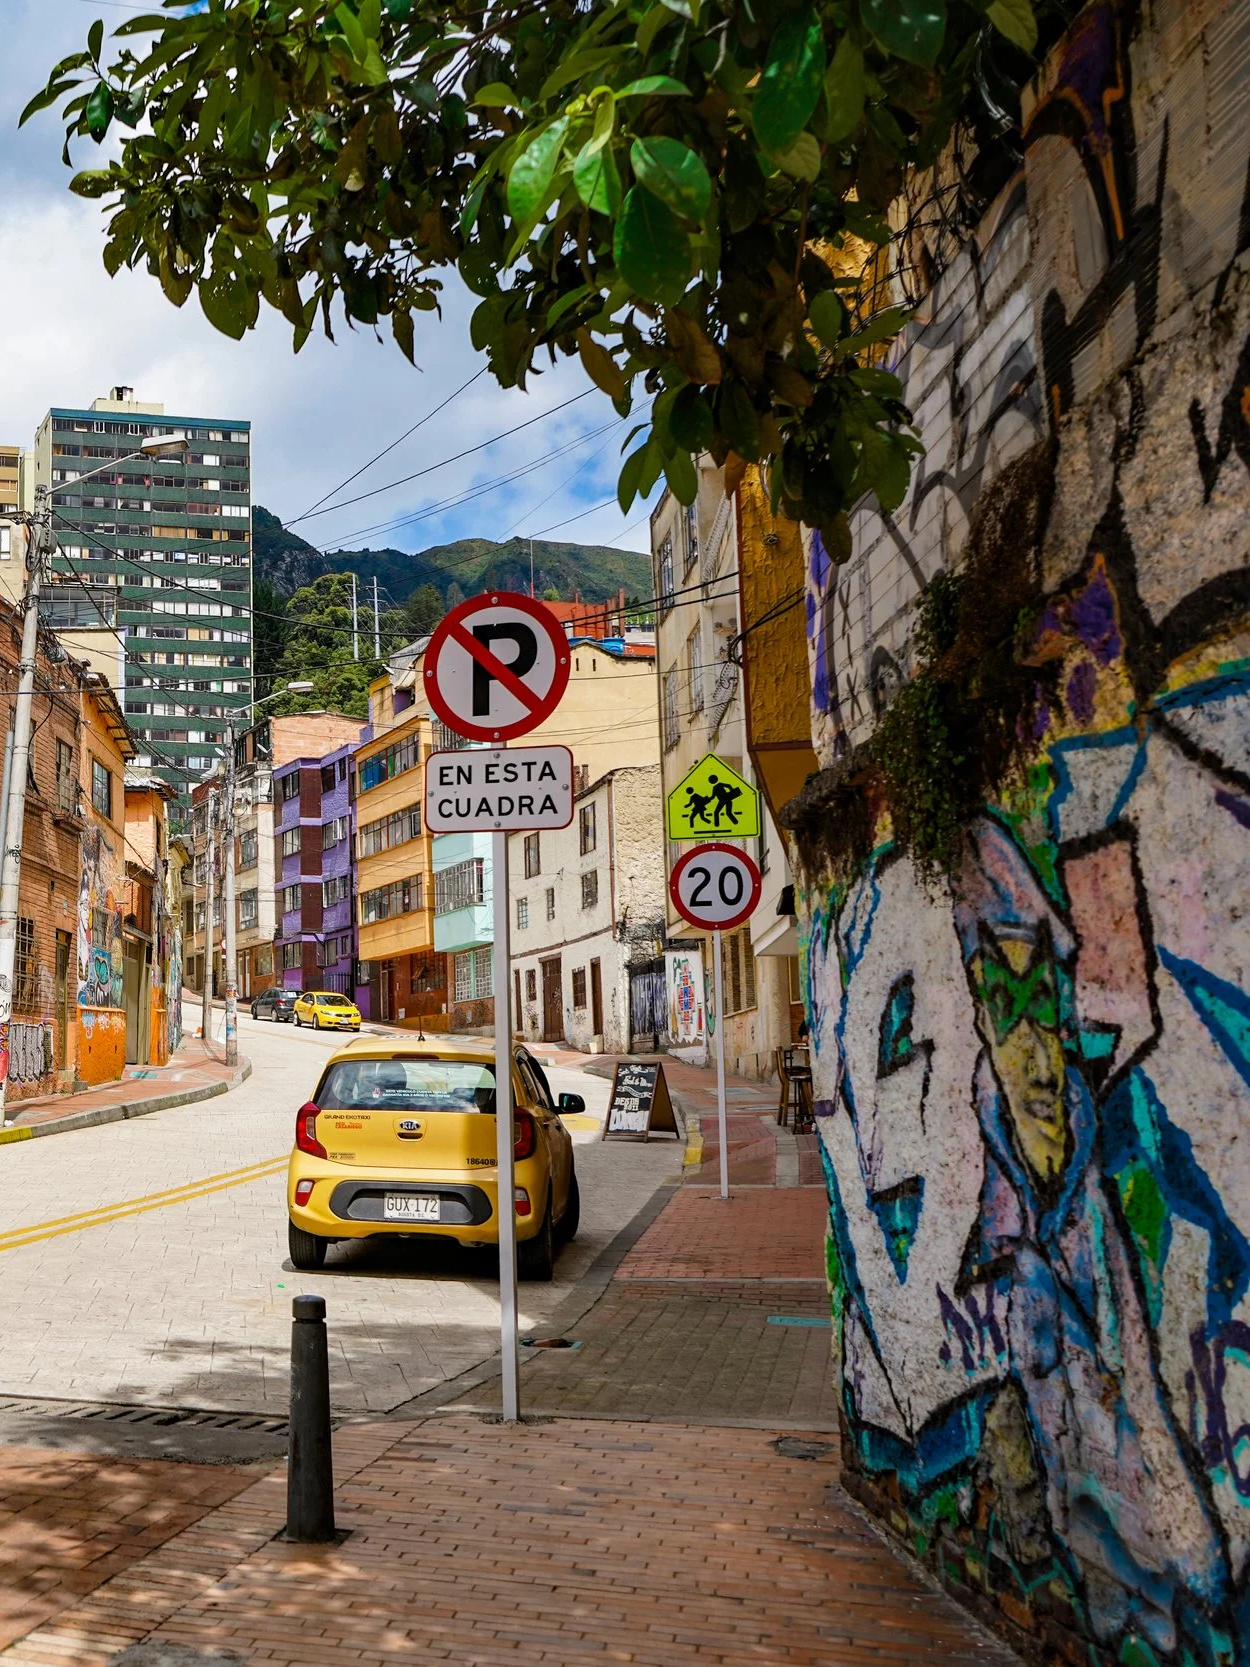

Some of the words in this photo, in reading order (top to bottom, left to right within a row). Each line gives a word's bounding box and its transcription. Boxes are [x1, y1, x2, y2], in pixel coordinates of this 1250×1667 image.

[472, 622, 538, 717] P
[439, 764, 472, 786] EN
[485, 760, 557, 784] ESTA
[438, 794, 559, 818] CUADRA
[687, 866, 744, 907] 20
[401, 1121, 419, 1130] KIA
[387, 1197, 410, 1212] GUX
[414, 1198, 438, 1213] 172
